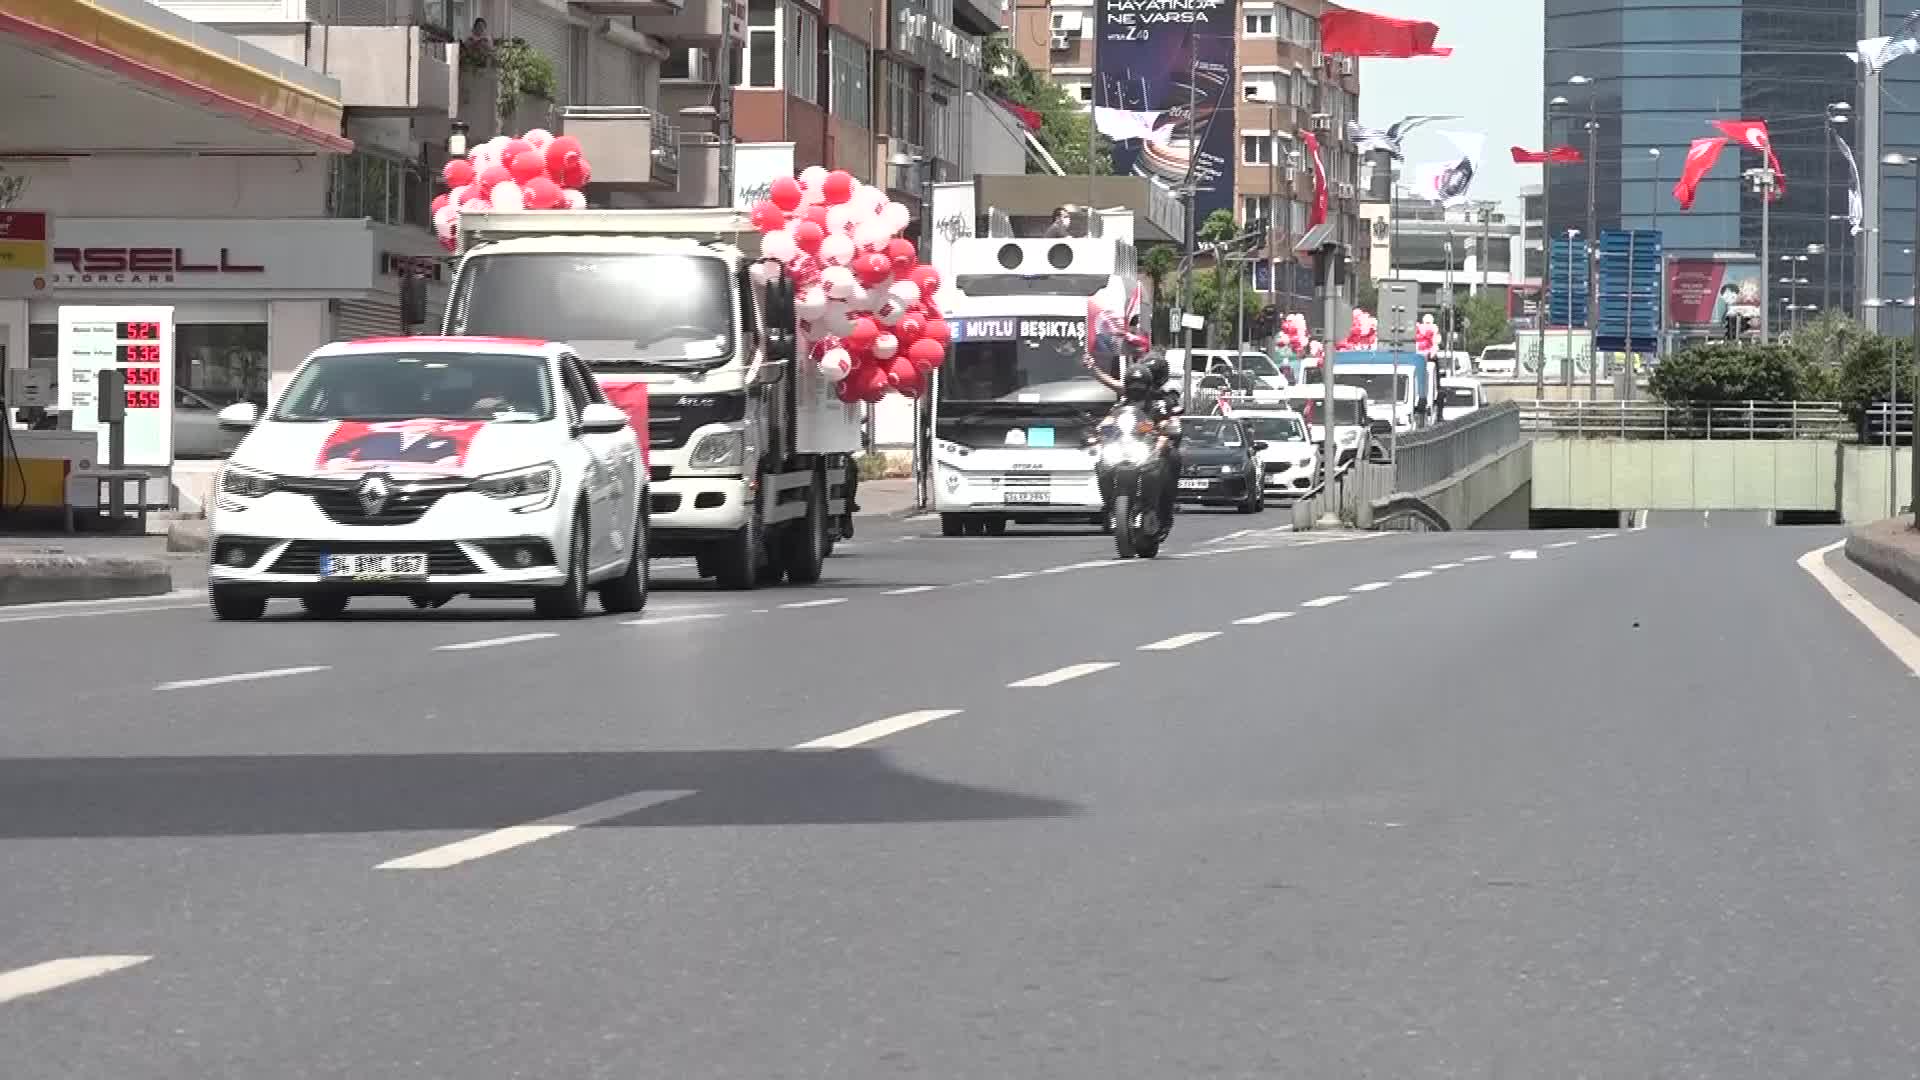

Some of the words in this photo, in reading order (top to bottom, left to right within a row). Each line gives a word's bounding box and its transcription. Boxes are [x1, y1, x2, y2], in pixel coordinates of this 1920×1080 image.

[1107, 13, 1137, 24] NE
[1140, 11, 1209, 23] VARSA
[966, 321, 1014, 337] MUTLU
[329, 557, 350, 574] 34
[355, 556, 386, 573] BYC
[392, 555, 424, 573] 667
